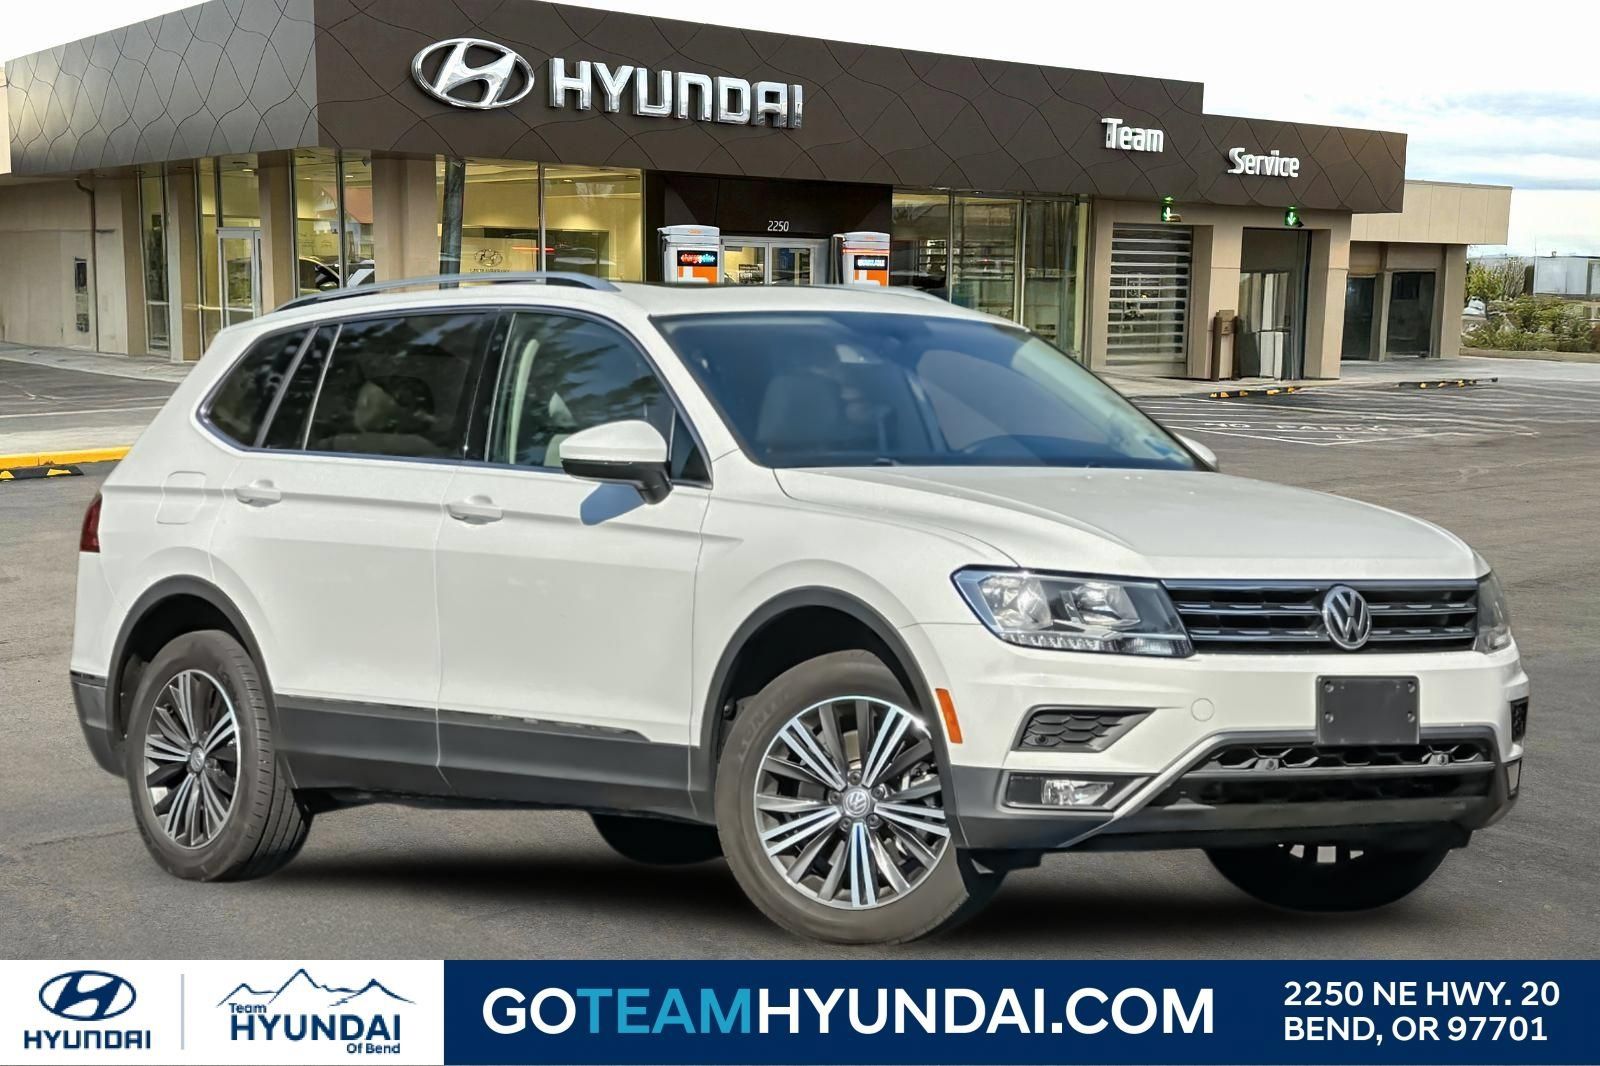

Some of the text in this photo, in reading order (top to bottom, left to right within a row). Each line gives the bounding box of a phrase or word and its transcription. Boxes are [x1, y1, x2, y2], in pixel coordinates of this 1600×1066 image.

[549, 57, 803, 129] HYUNDAI
[1101, 117, 1164, 152] Team
[1227, 147, 1300, 177] Service
[767, 220, 790, 232] 2250
